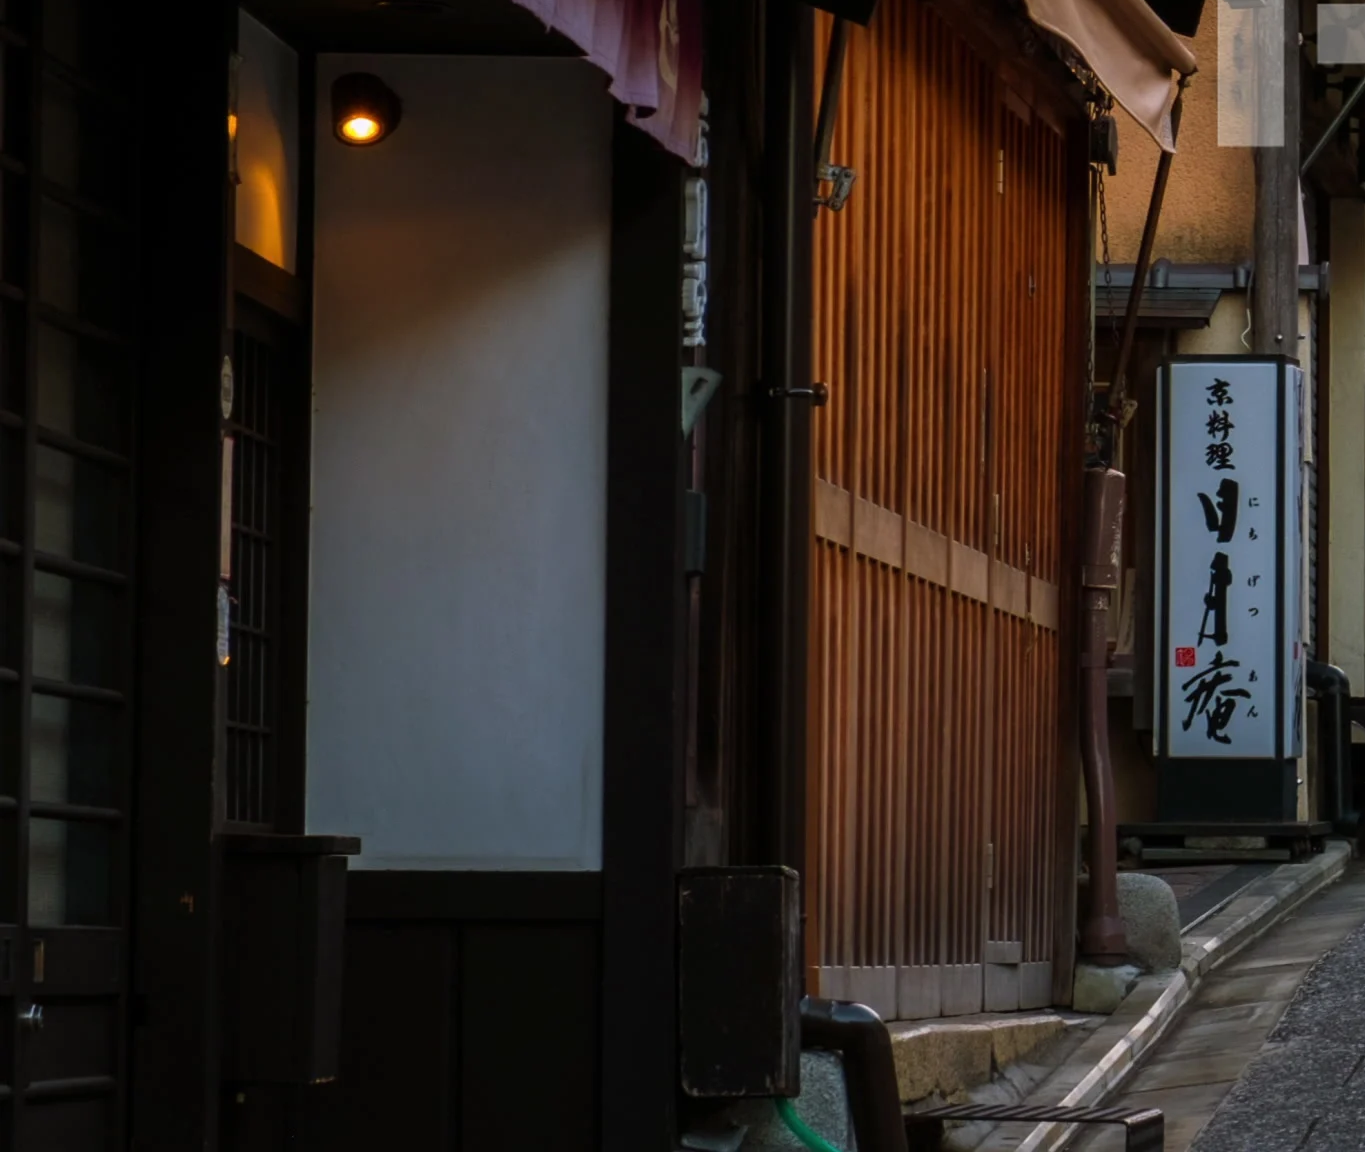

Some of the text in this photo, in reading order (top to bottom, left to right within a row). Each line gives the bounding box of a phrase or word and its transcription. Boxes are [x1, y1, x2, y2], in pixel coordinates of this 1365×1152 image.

[1206, 378, 1235, 470] 京料理
[1181, 477, 1251, 745] 日月庵
